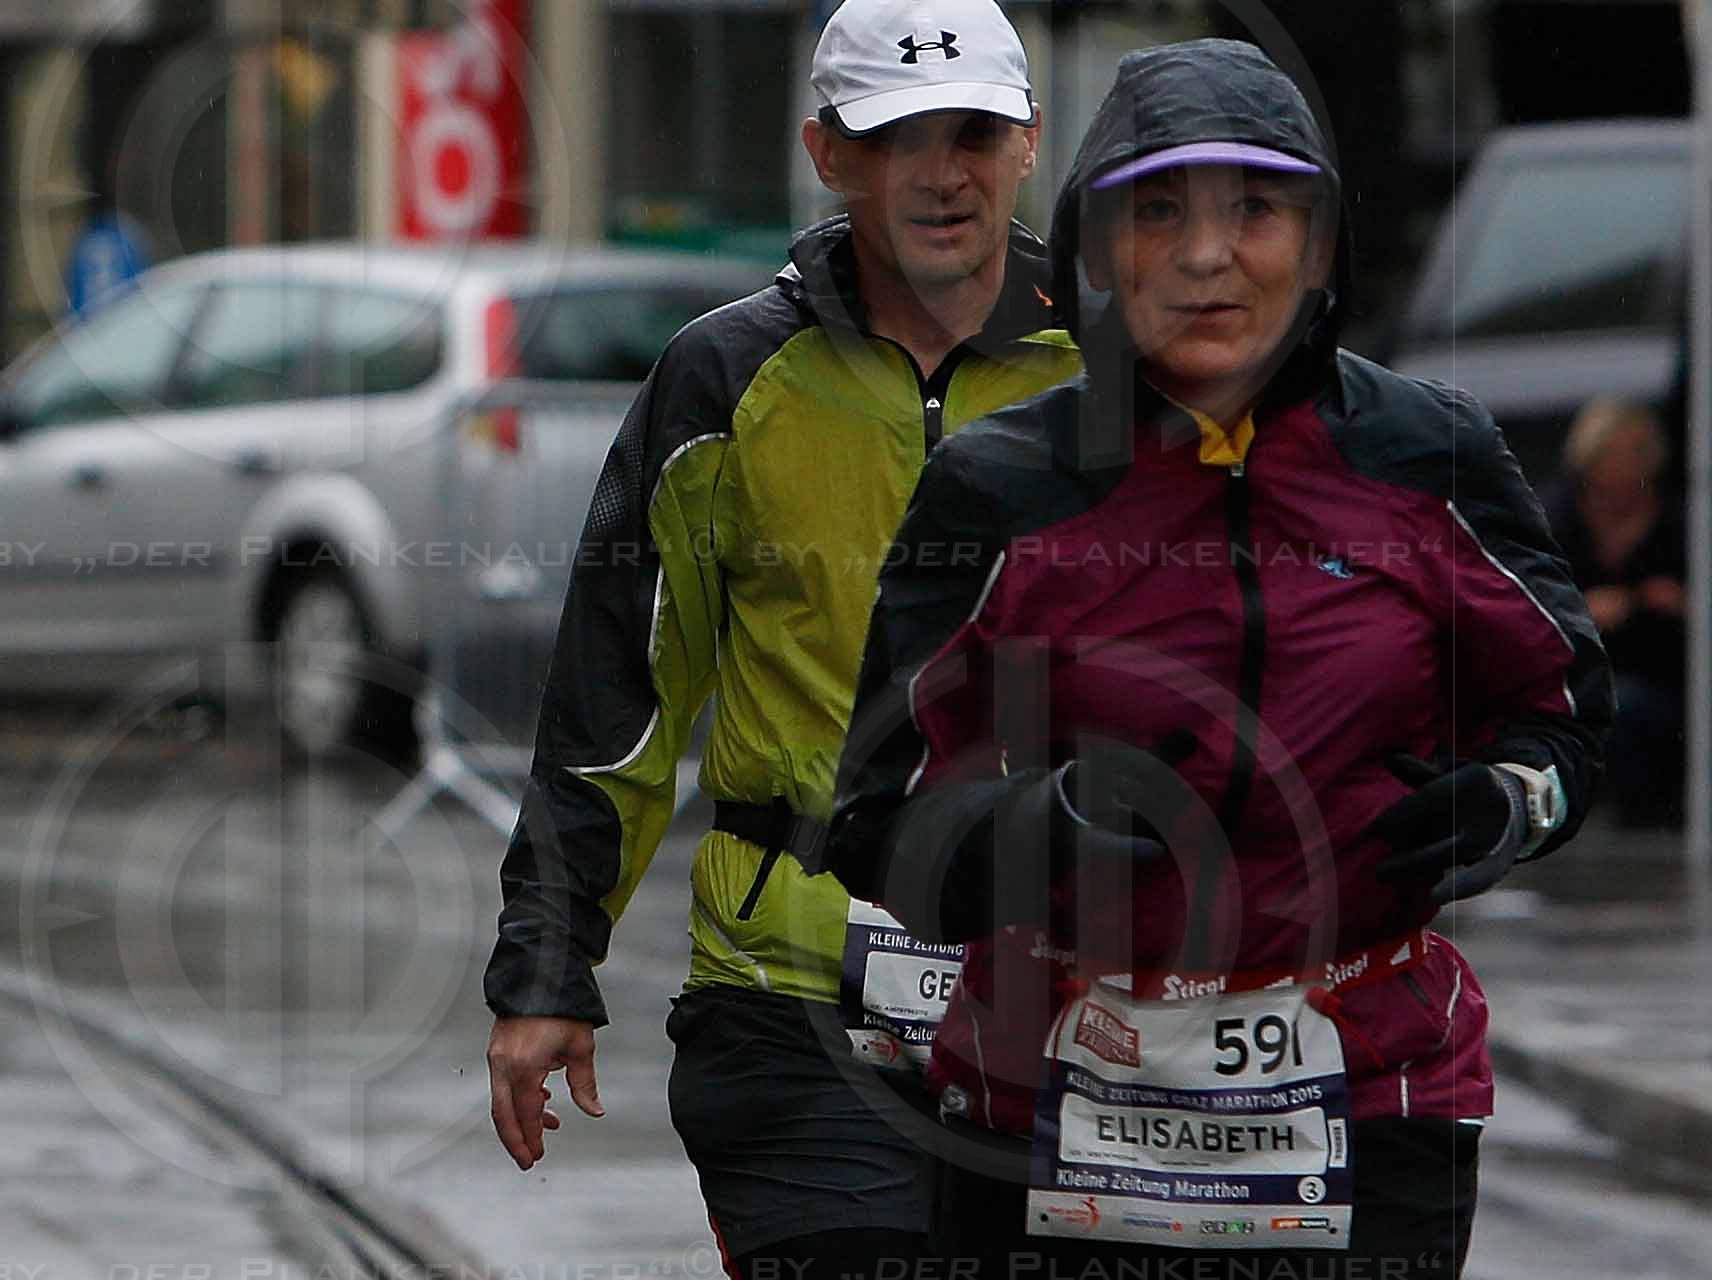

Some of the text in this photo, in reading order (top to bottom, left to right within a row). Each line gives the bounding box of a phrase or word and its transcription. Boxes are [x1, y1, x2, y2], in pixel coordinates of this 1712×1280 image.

[868, 930, 911, 949] KLEINE
[1288, 1083, 1324, 1105] 2015
[1095, 1114, 1296, 1154] ELISABETH
[1056, 1168, 1250, 1200] Kleine Zeitung Marathon
